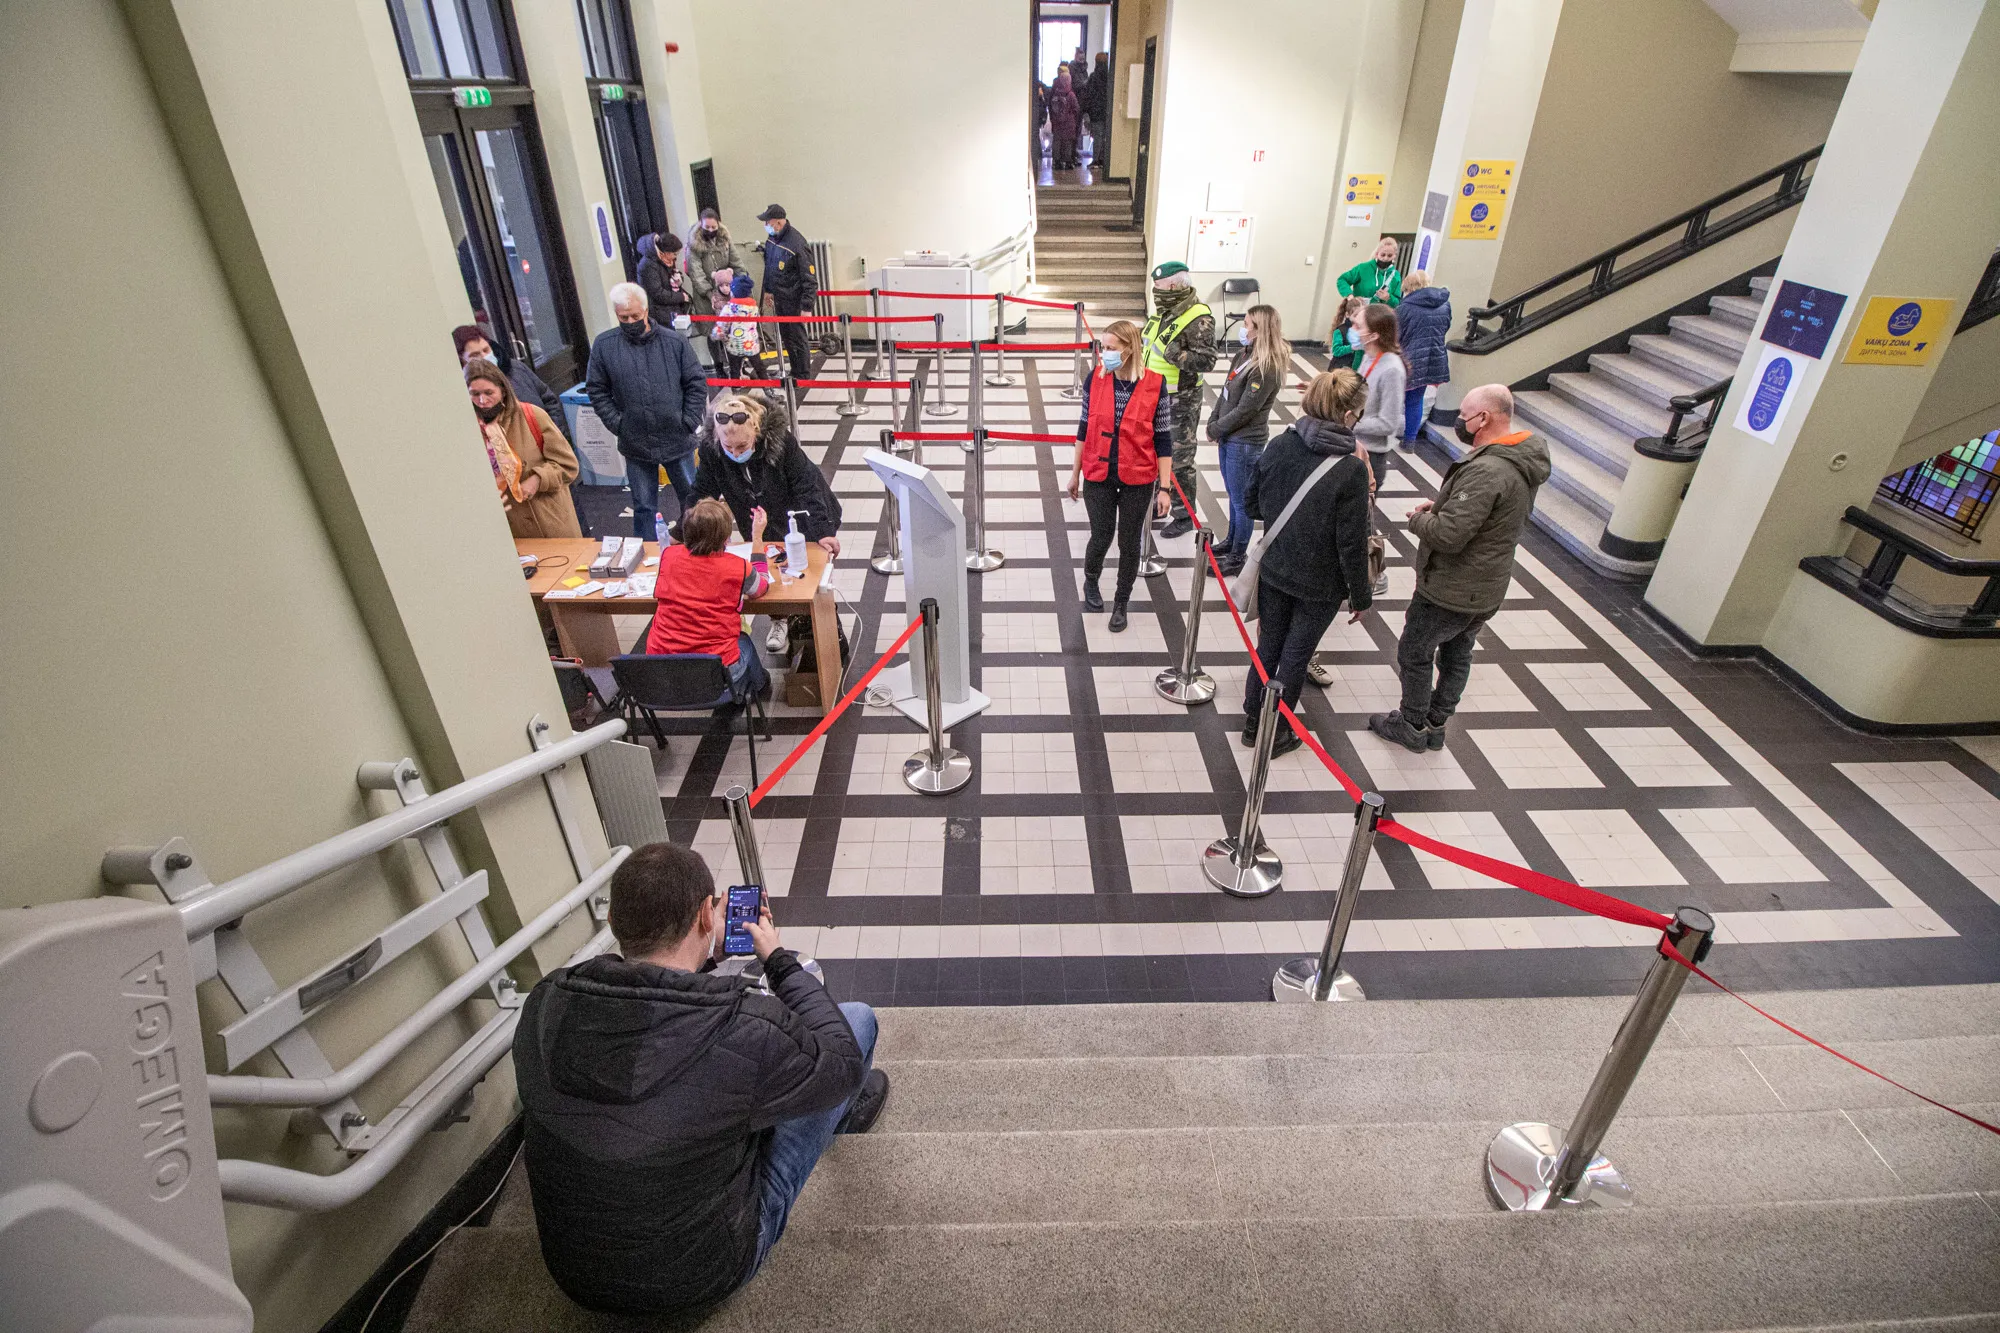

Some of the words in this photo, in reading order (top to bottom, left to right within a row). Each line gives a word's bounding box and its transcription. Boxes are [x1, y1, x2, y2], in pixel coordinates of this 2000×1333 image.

[1865, 339, 1888, 347] VAIKŲ
[1889, 339, 1911, 347] ZONA
[120, 950, 191, 1202] OMEGA
